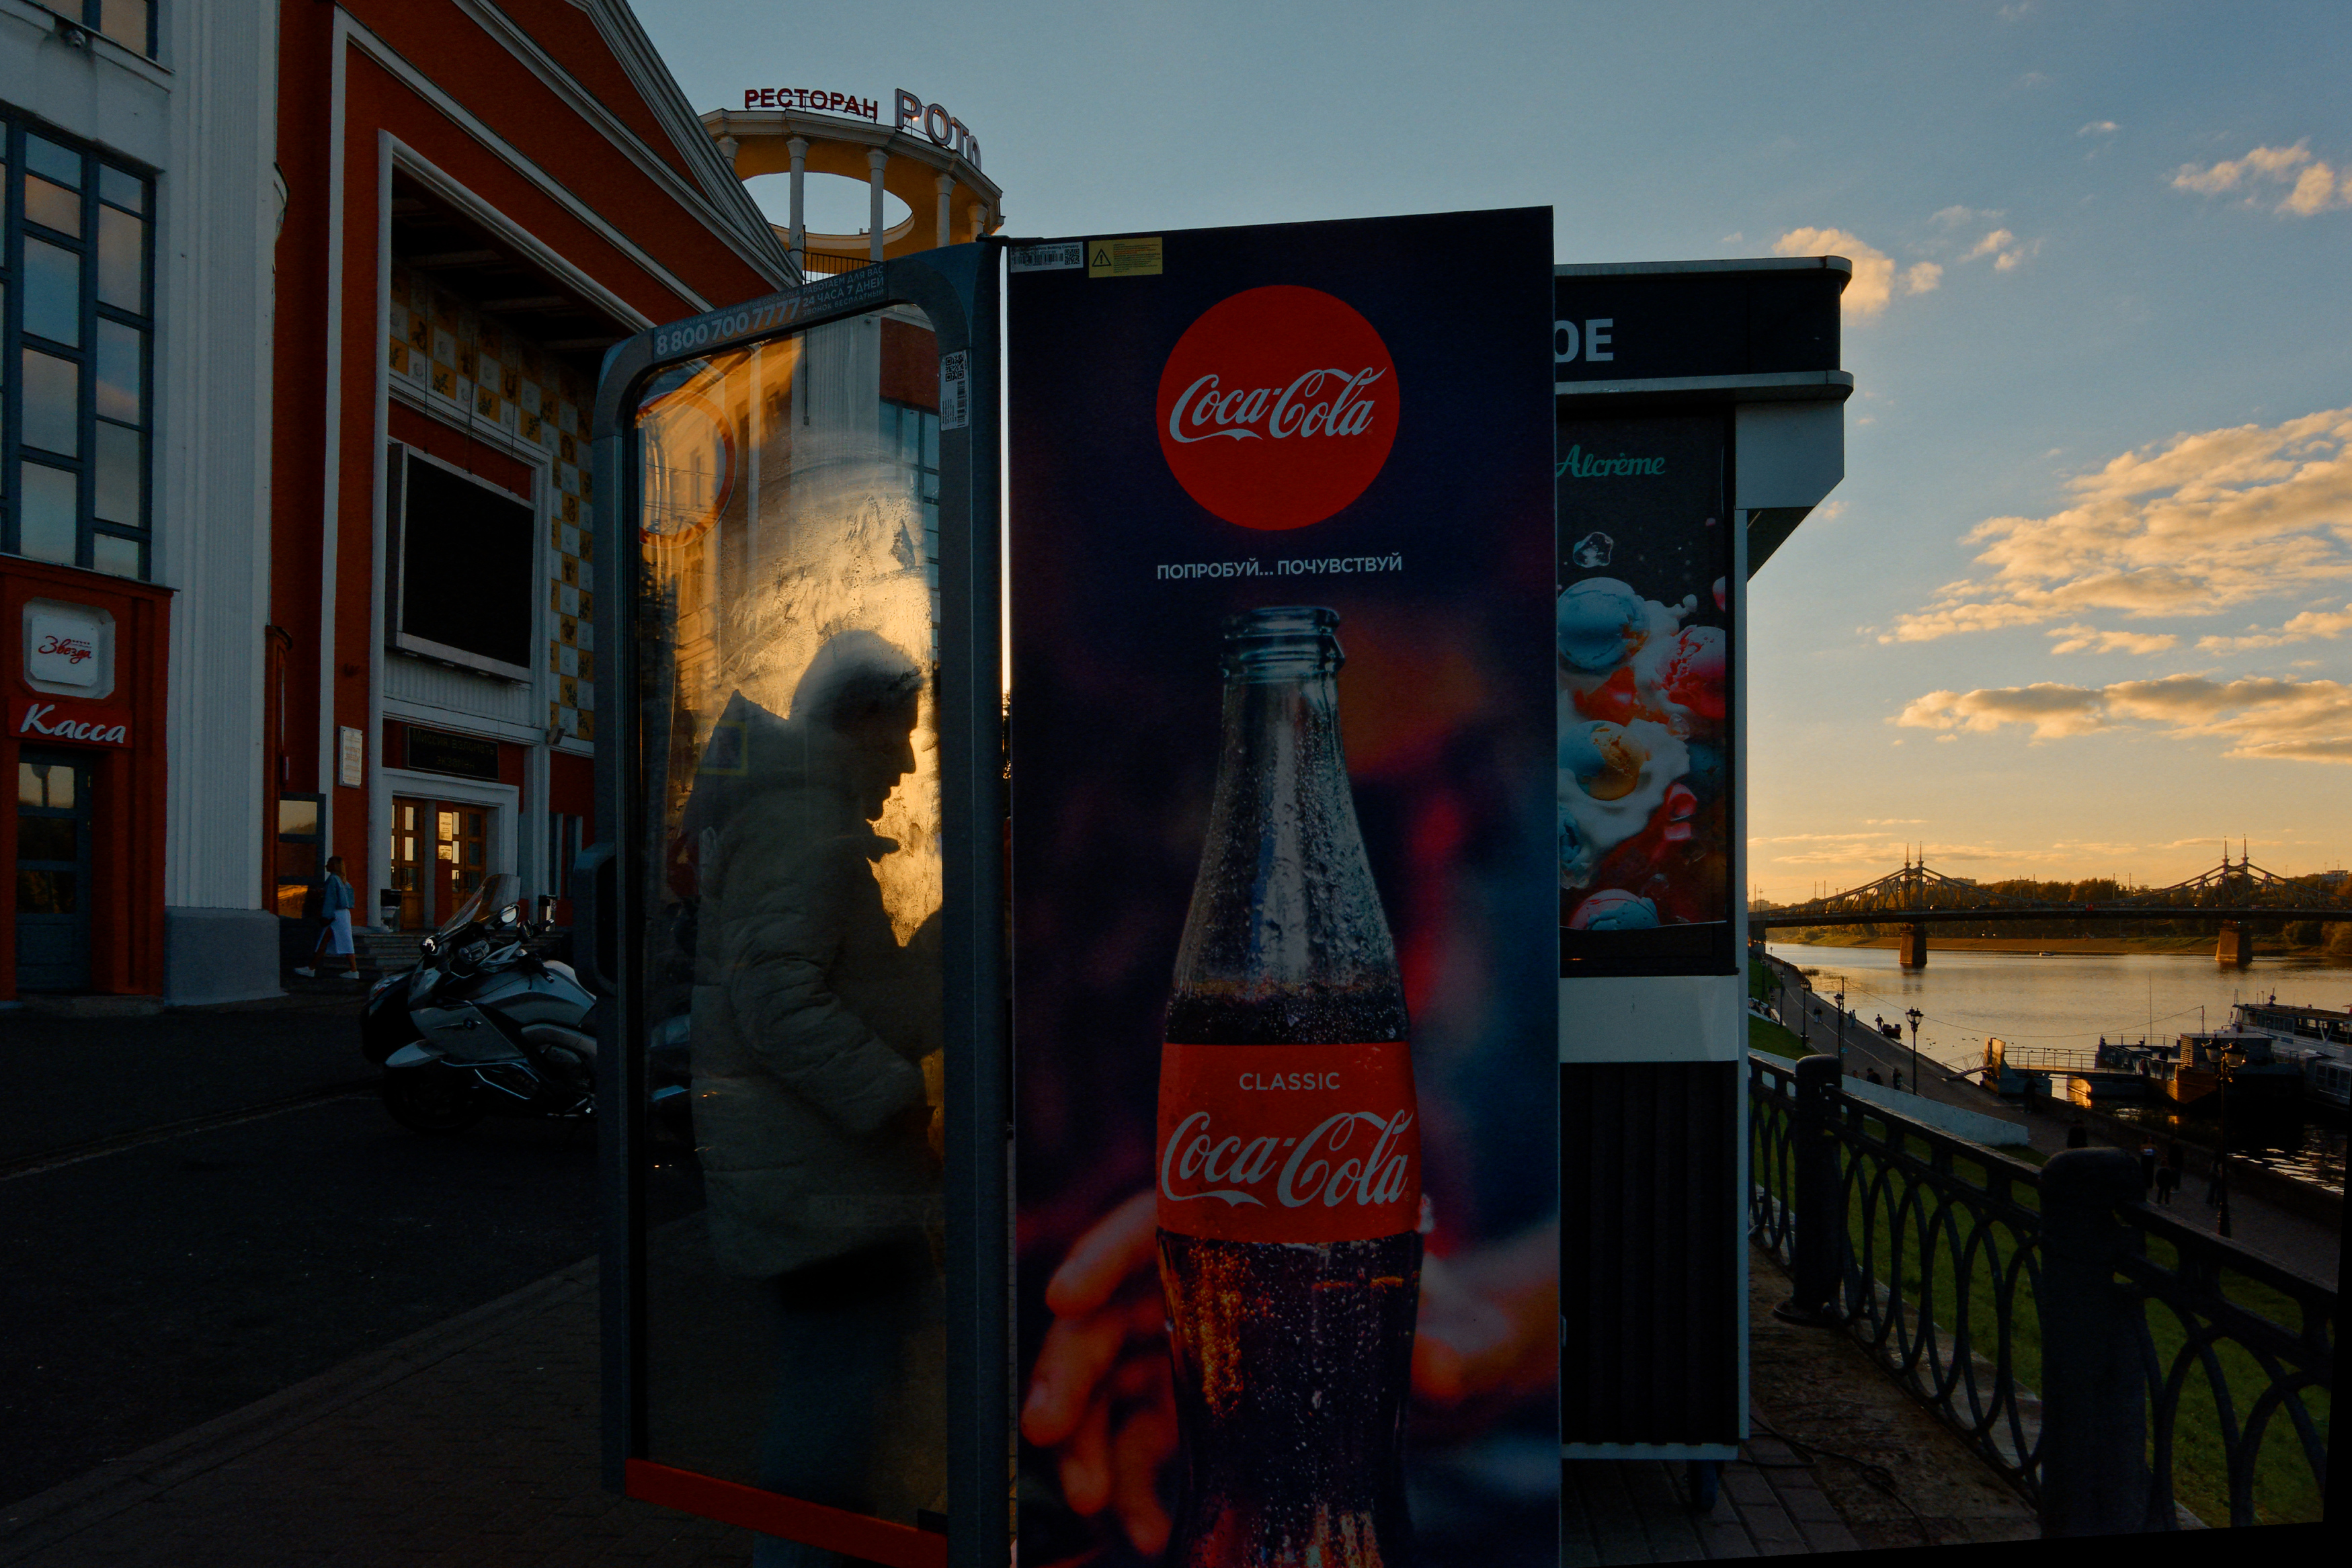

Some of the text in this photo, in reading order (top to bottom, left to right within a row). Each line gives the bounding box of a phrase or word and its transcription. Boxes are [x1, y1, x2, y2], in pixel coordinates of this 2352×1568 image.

[745, 88, 878, 120] РЕСТОРАН
[803, 265, 883, 295] РАБОТАЕМ ДЛЯ ВАС
[803, 274, 885, 307] 24 ЧАСА 7 ДНЕЙ
[803, 287, 885, 317] ЗВОНОК БЕСПЛАТНЫЙ
[657, 296, 801, 356] 8 800 700 7777
[1169, 366, 1387, 444] Coca-Cola
[1157, 552, 1403, 579] ПОПРОБУЙ... ПОЧУВСТВУЙ
[38, 635, 92, 664] Звезда
[20, 703, 126, 744] Касса
[1238, 1072, 1341, 1091] CLASSIC
[1161, 1109, 1414, 1209] Coca-Cola
